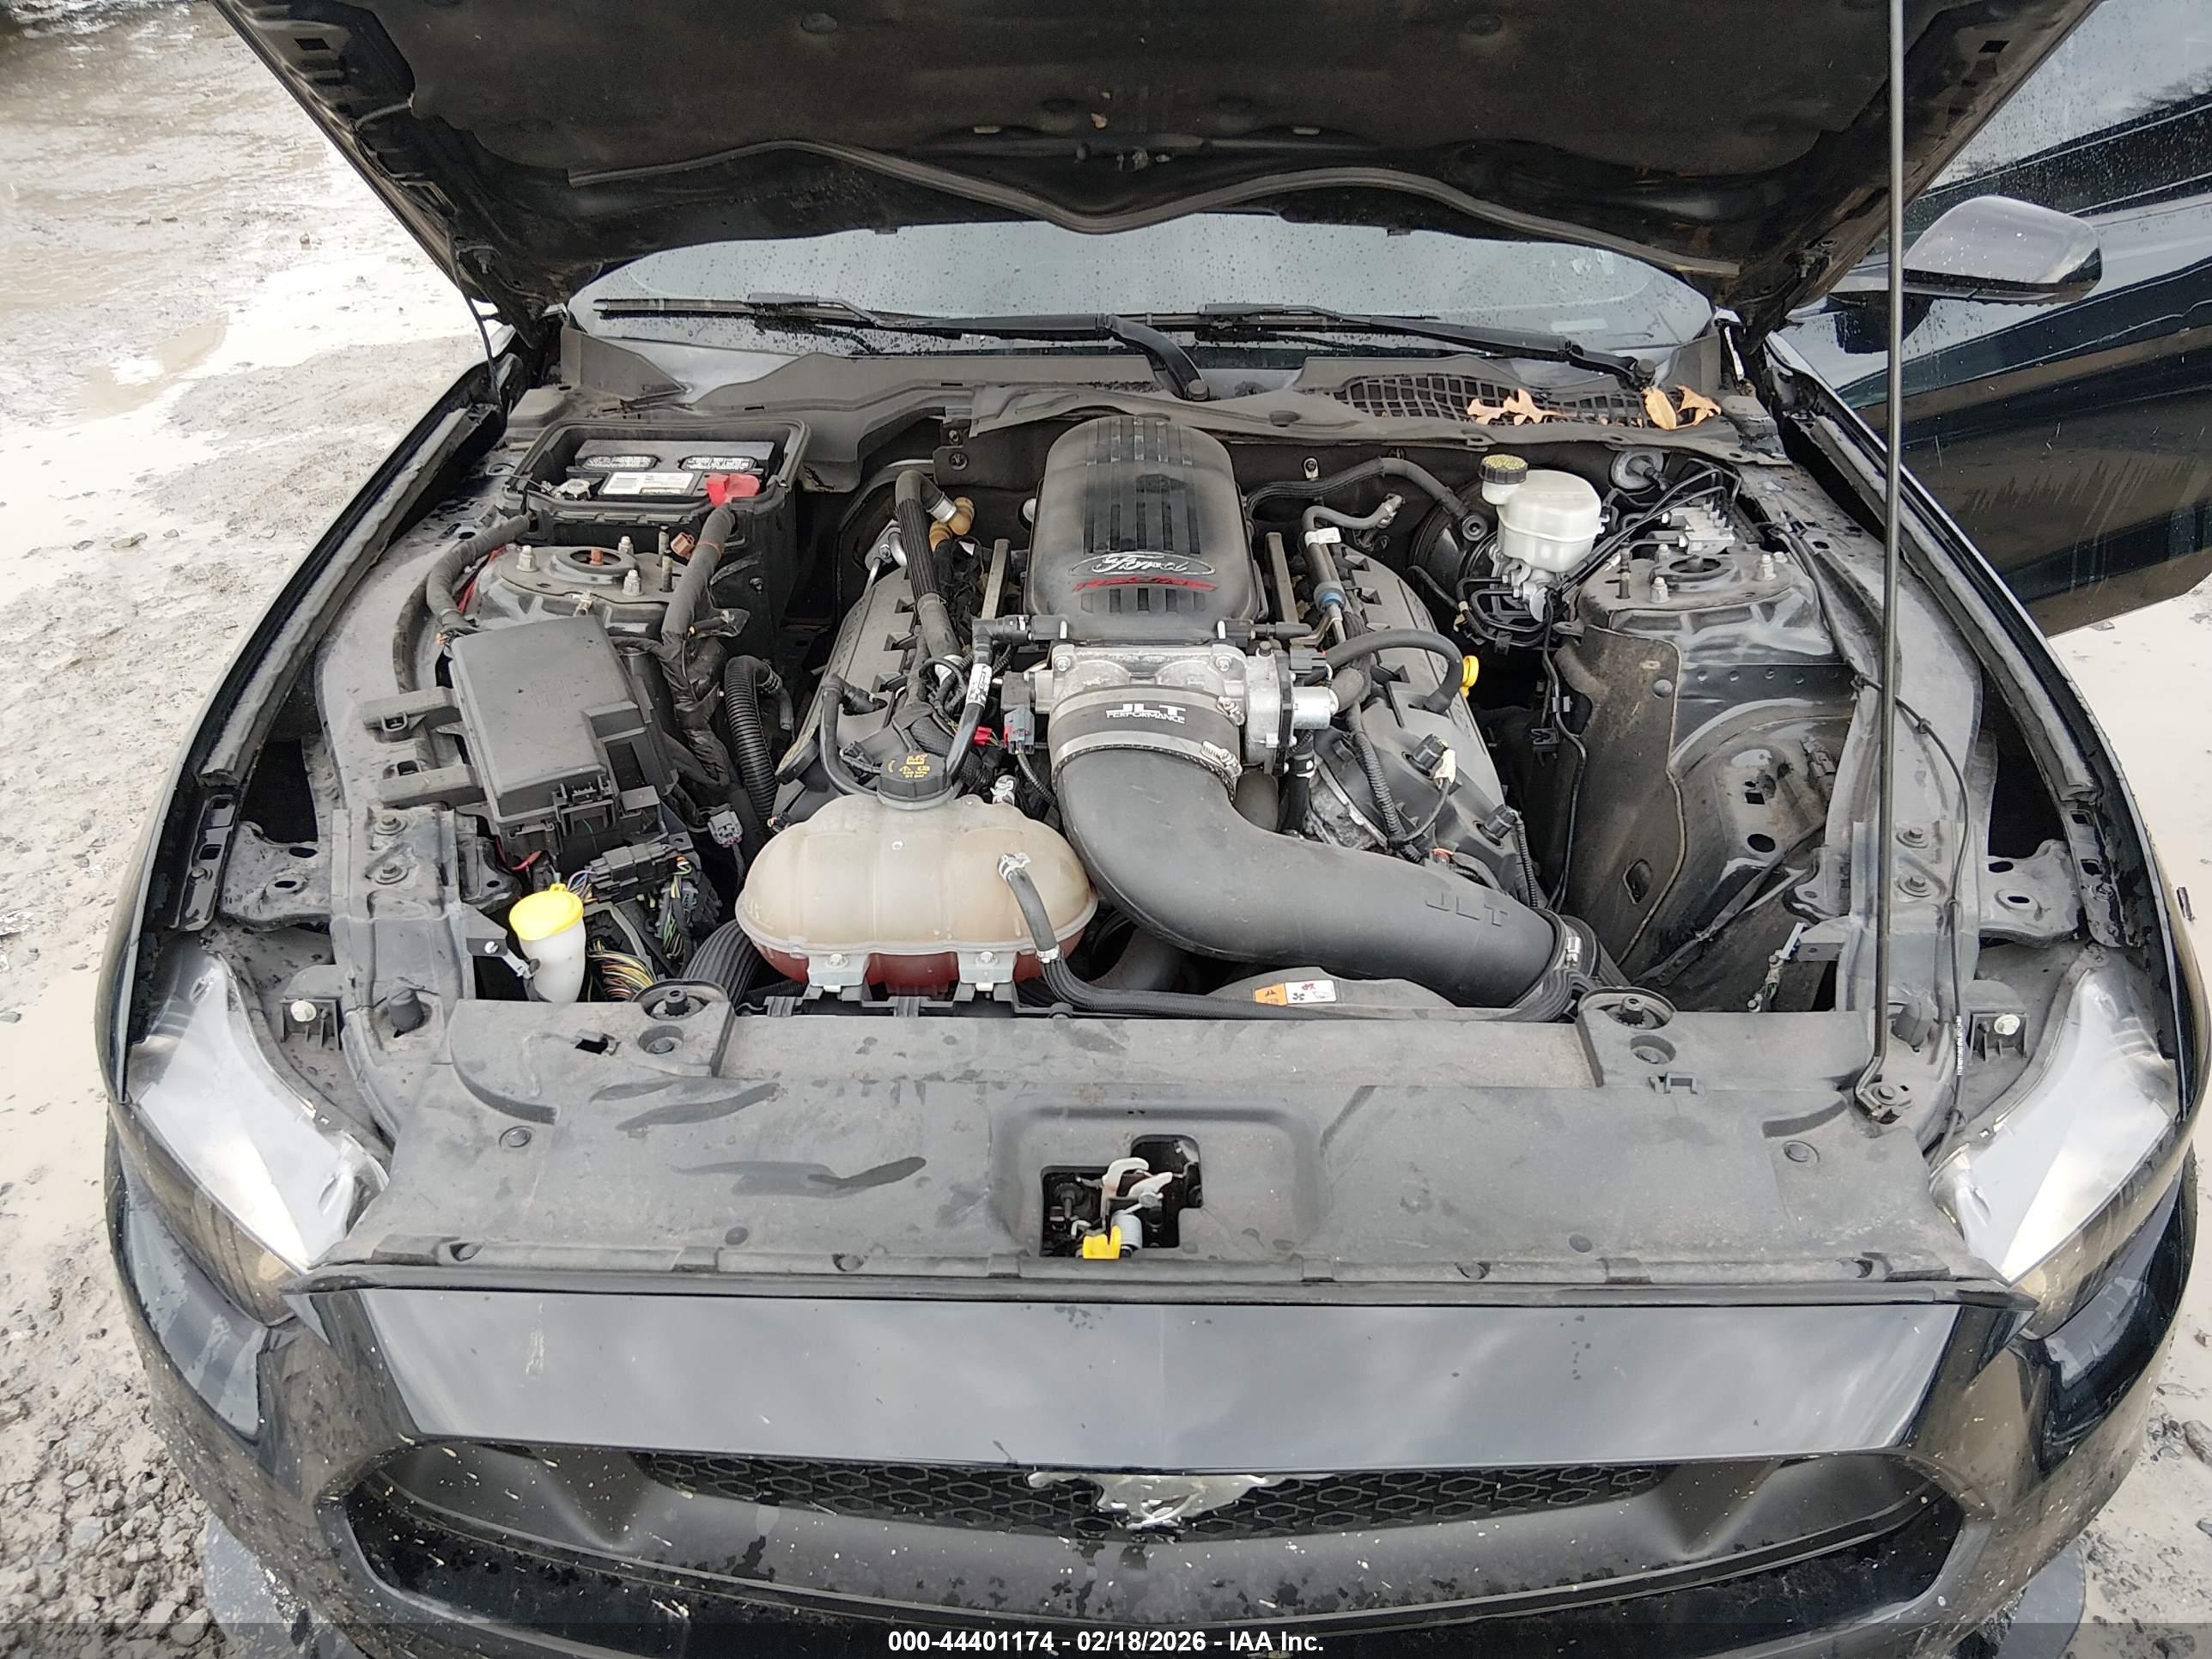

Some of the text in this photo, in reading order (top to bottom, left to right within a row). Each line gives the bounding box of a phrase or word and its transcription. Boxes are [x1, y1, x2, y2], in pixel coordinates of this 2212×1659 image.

[1091, 555, 1189, 573] Ford
[1106, 703, 1186, 716] JLT
[1107, 712, 1185, 724] PERFORMANCE
[1425, 891, 1509, 927] JLT
